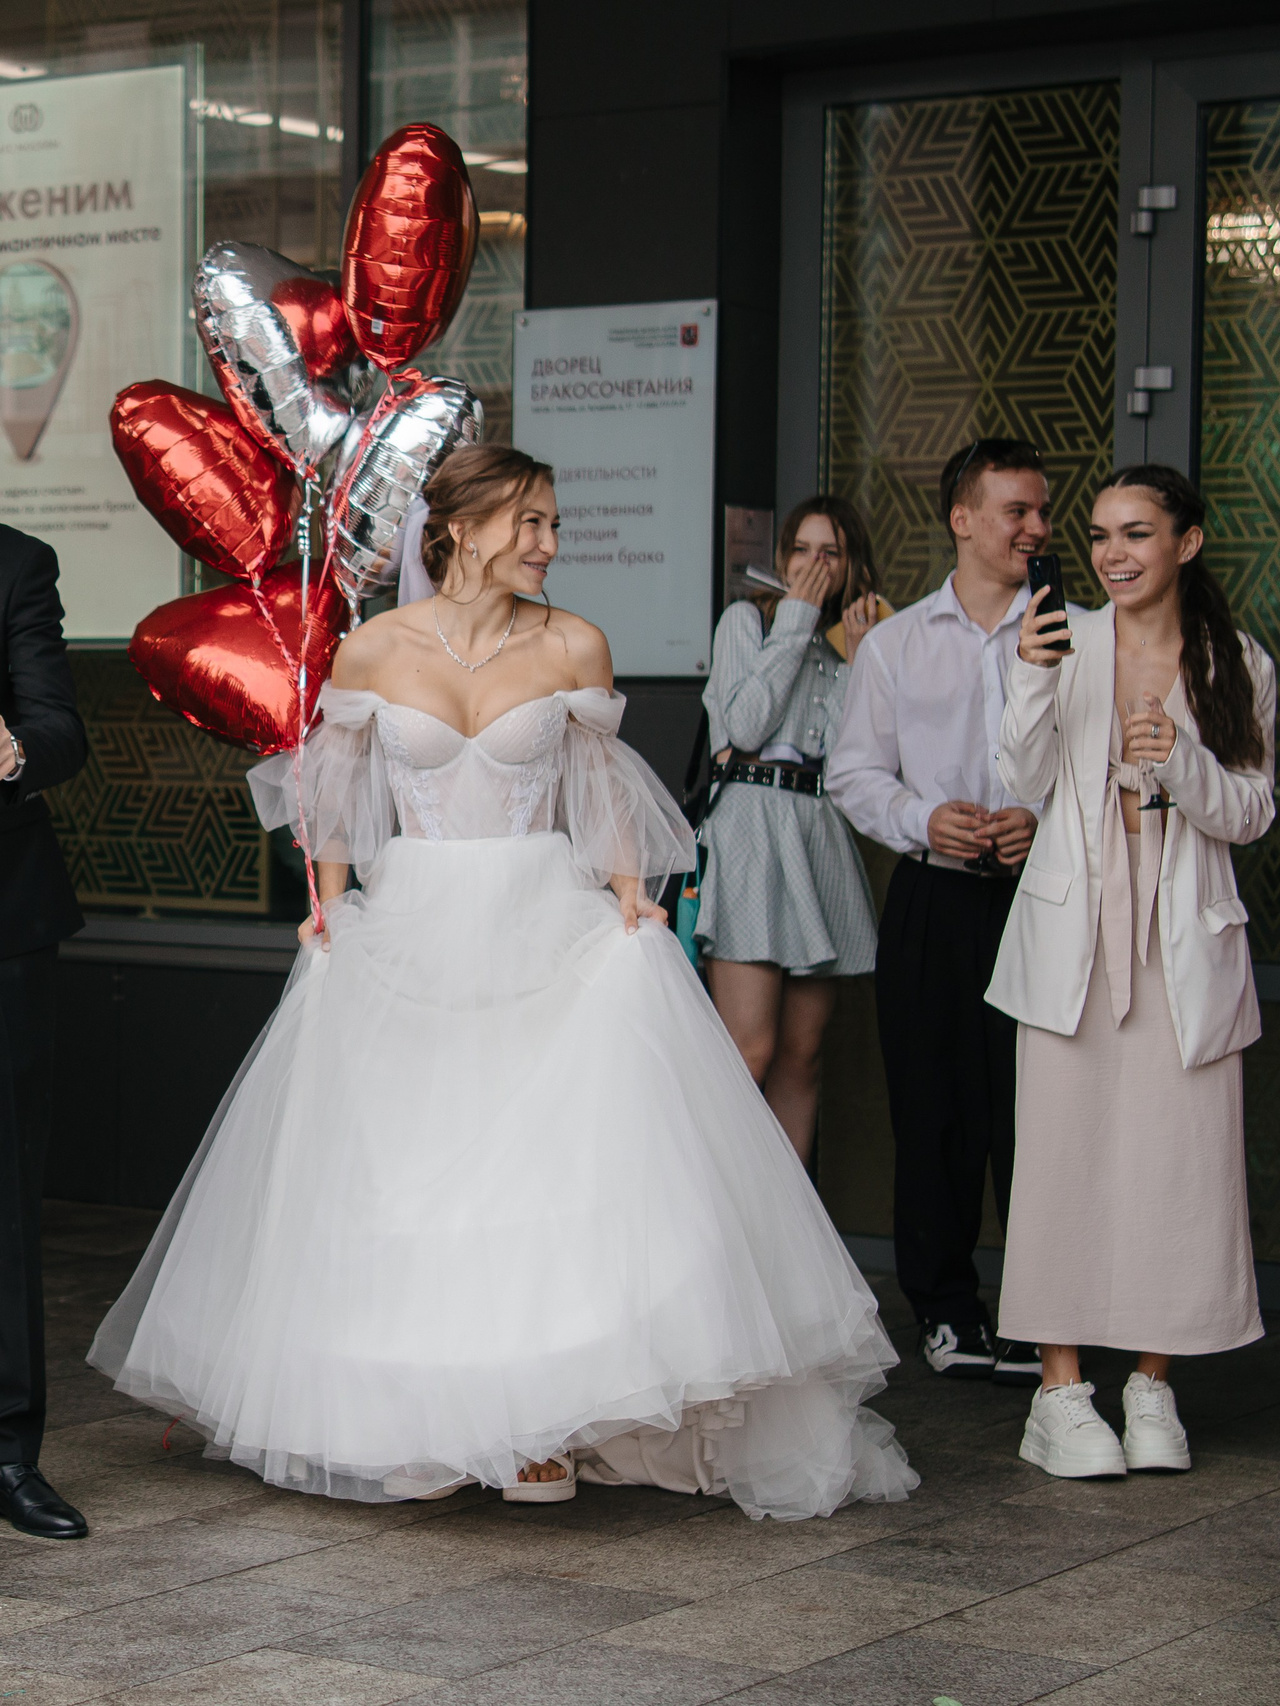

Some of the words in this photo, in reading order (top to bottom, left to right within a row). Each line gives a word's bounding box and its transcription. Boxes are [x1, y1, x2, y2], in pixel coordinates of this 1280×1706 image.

[105, 227, 162, 245] месте
[531, 356, 602, 377] ДВОРЕЦ
[531, 377, 694, 401] БРАКОСОЧЕТАНИЯ
[558, 466, 657, 483] ДЕЯТЕЛЬНОСТИ
[618, 546, 664, 567] брака
